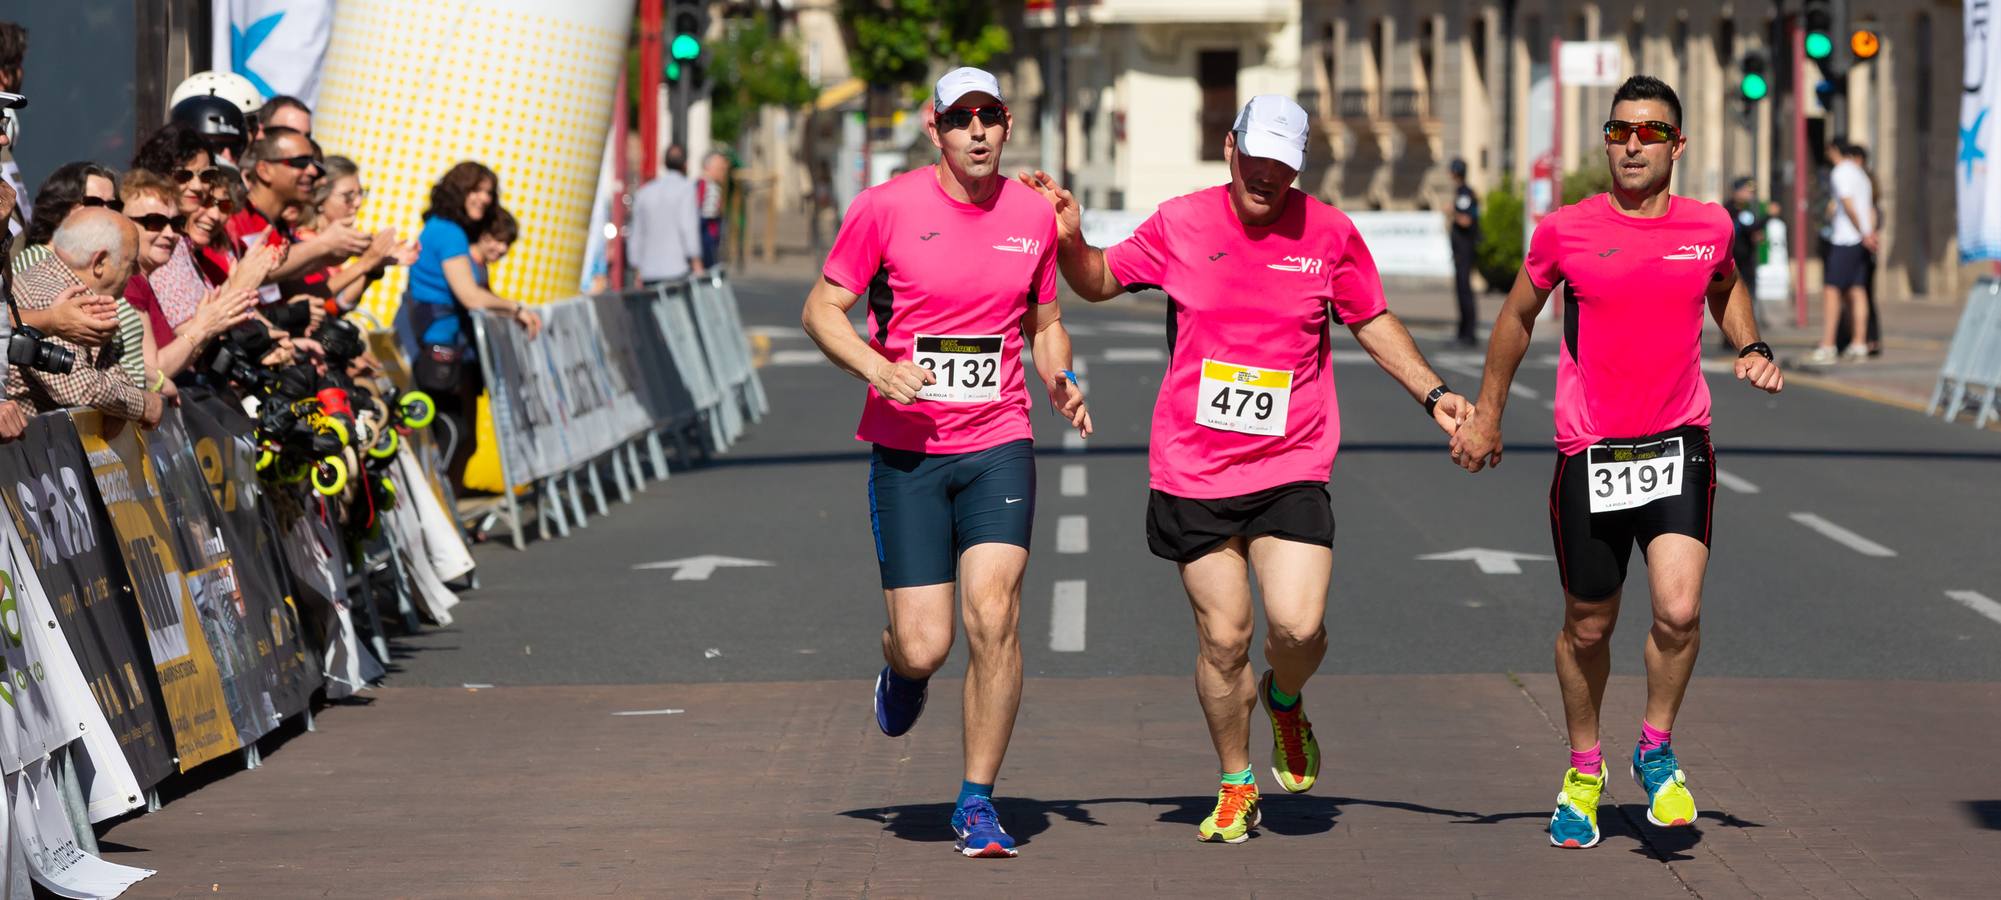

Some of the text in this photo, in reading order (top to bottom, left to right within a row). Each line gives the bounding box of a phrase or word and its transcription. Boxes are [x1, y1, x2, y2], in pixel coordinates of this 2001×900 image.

[918, 357, 997, 389] 3132
[1210, 386, 1274, 421] 479
[1594, 461, 1675, 498] 3191
